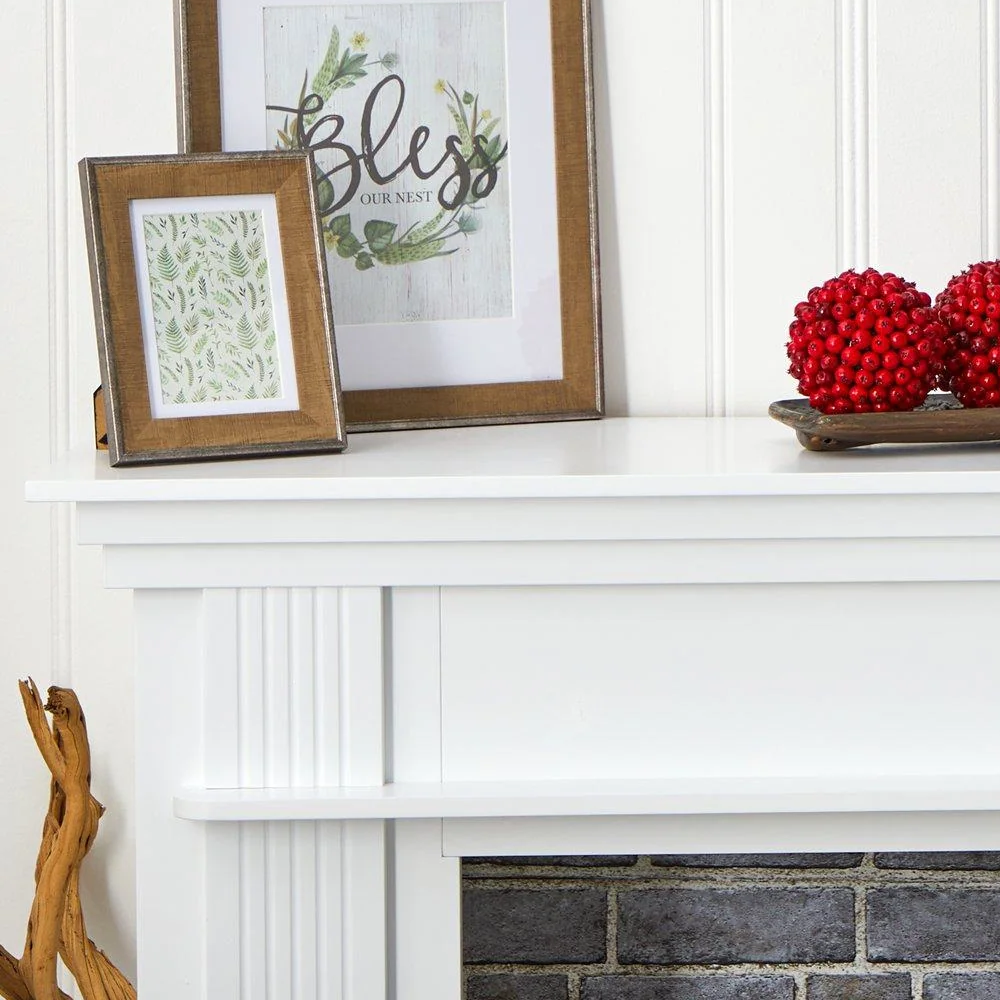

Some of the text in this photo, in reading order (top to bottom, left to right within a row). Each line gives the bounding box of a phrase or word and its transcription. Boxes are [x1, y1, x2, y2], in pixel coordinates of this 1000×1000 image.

[265, 73, 508, 217] Bless
[360, 190, 433, 206] OUR NEST
